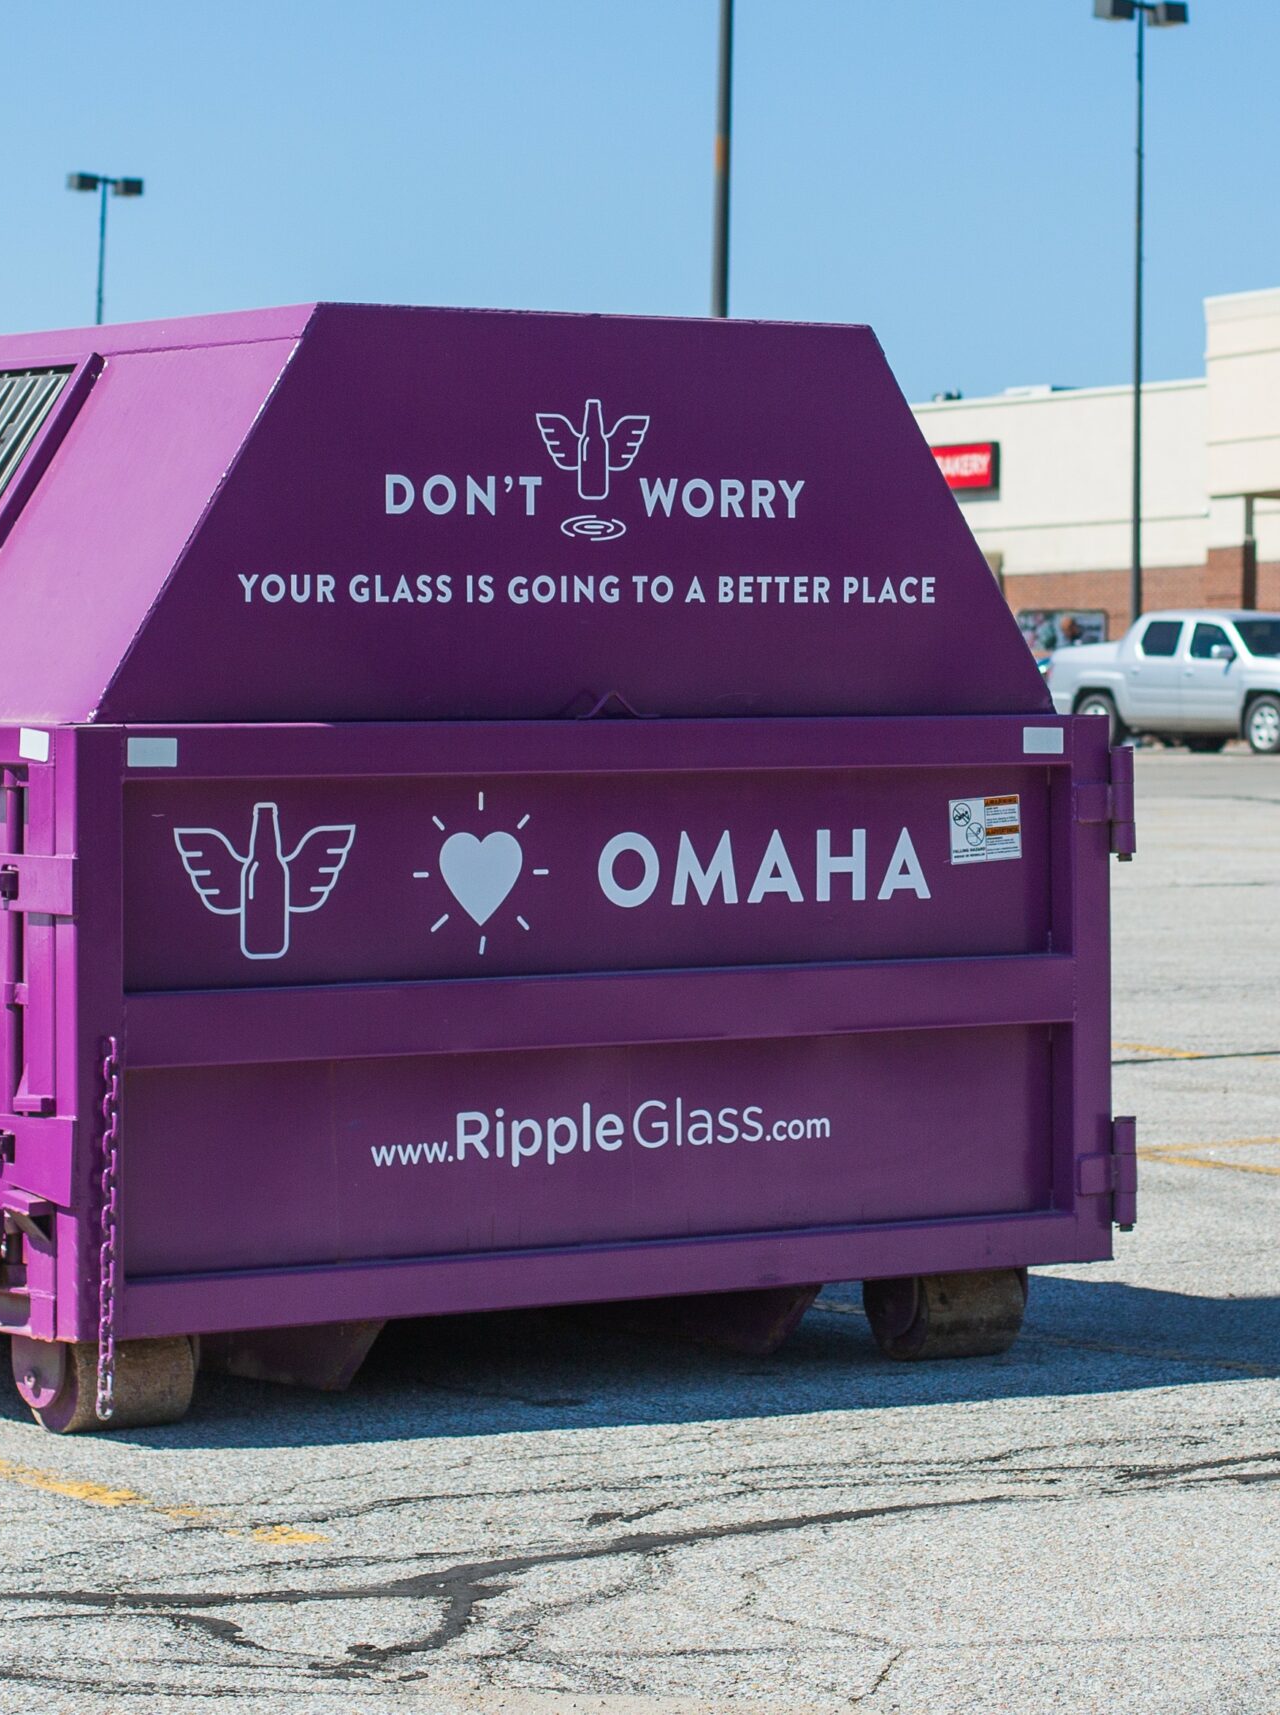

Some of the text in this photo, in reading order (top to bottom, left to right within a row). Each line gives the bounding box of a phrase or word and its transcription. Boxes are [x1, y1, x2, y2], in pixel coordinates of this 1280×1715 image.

[385, 473, 806, 519] DON'T WORRY
[237, 573, 936, 605] YOUR GLASS IS GOING TO A BETTER PLACE
[597, 826, 932, 908] OMAHA
[370, 1096, 831, 1168] www.RippleGlass.com
